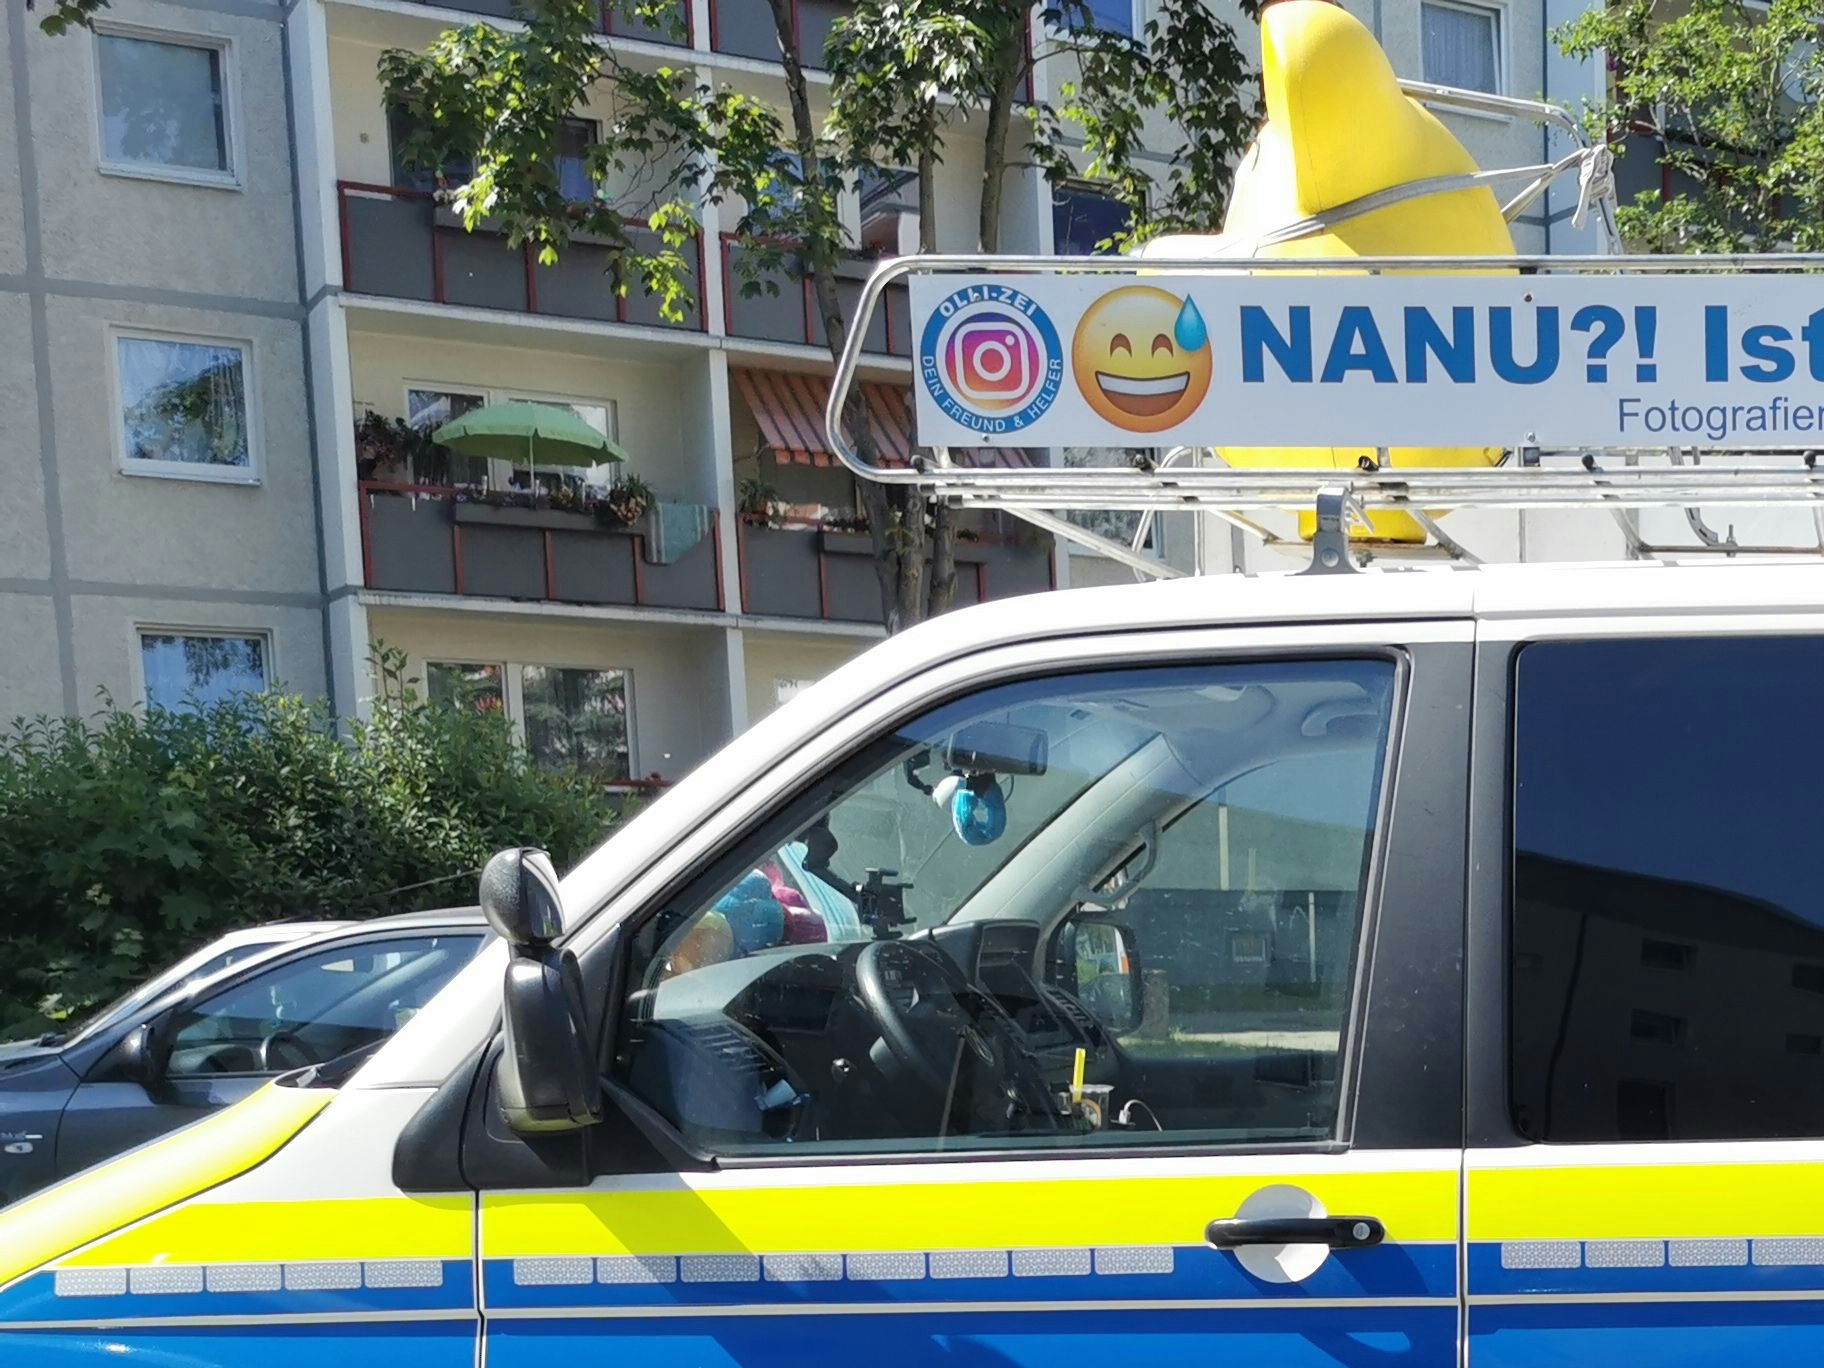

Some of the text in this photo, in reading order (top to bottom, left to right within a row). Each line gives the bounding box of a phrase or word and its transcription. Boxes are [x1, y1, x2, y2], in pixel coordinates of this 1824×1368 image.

[939, 286, 1038, 317] OLLI-ZEI
[1240, 305, 1656, 384] NANU?!
[922, 356, 1061, 432] DEIN FREUND & HELFER
